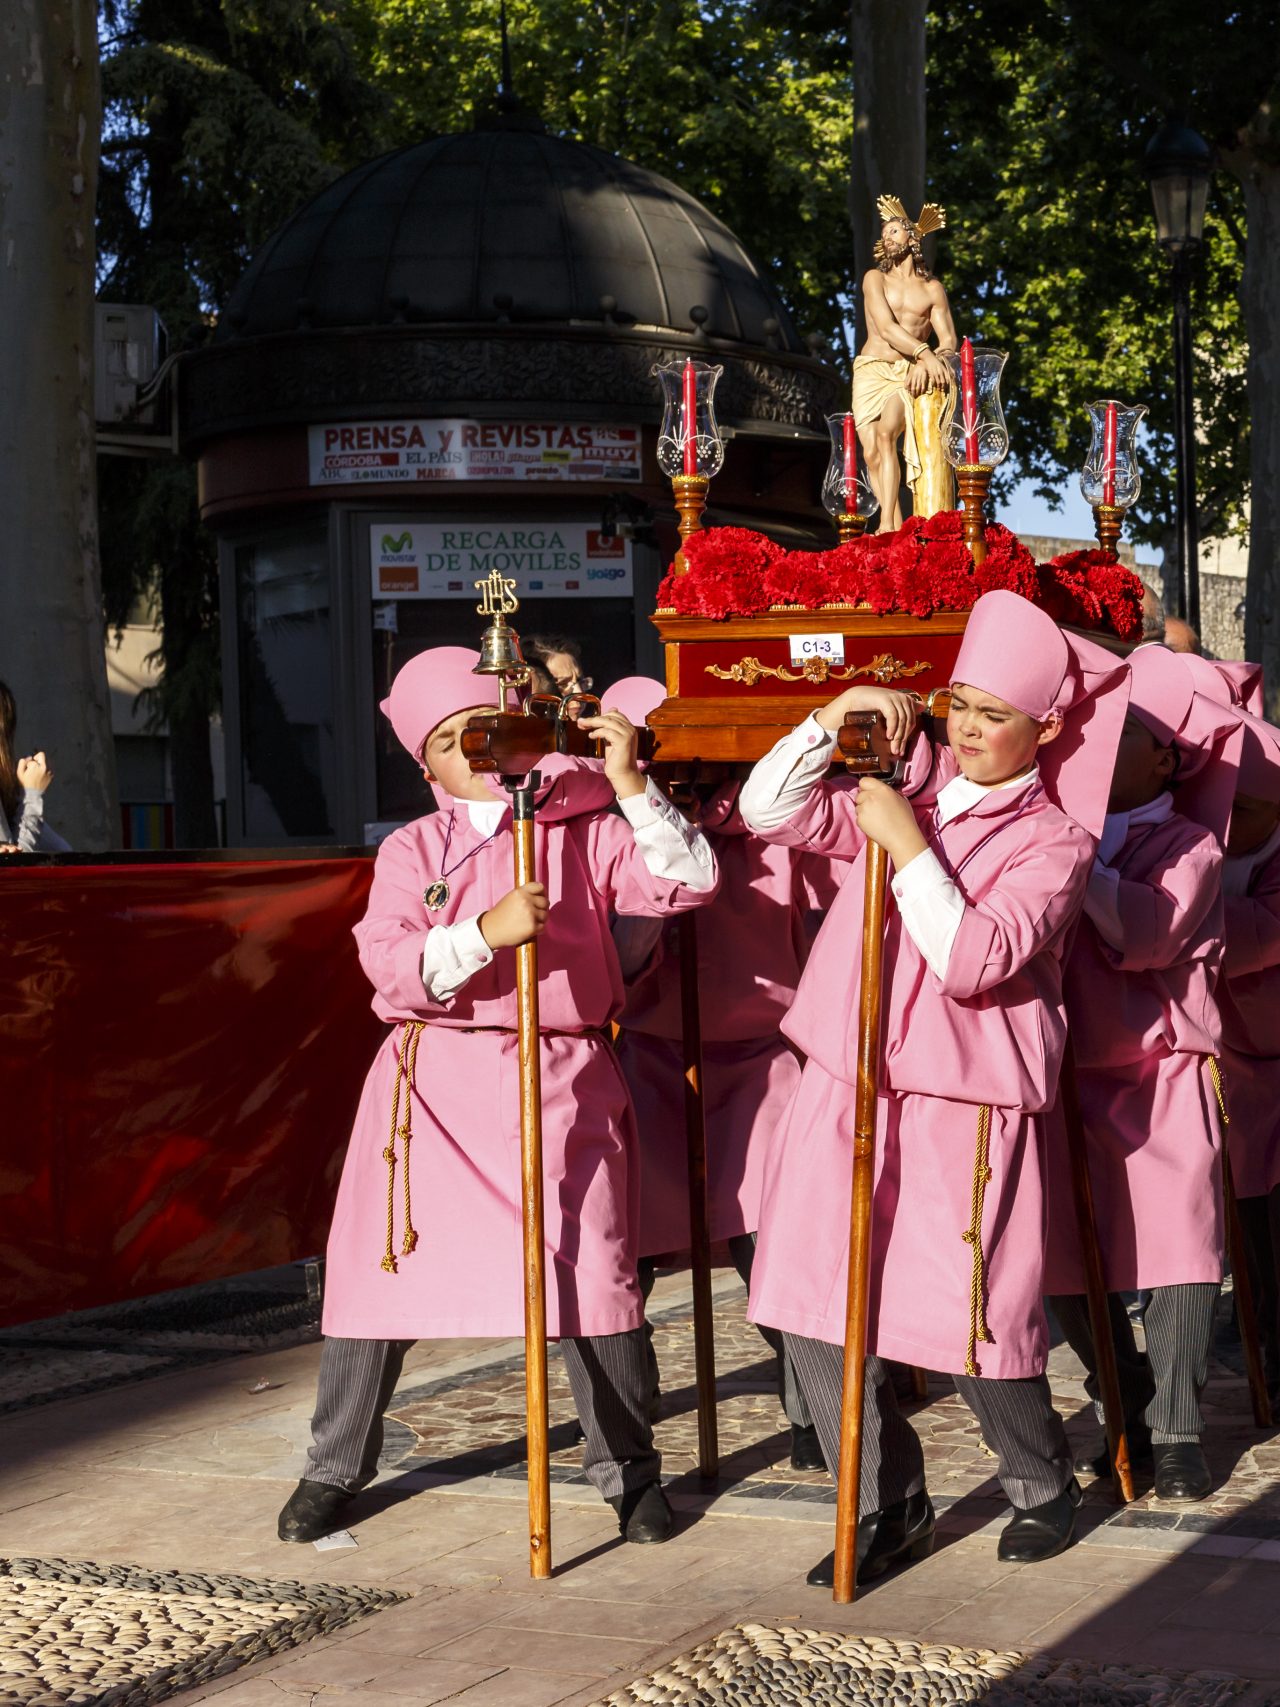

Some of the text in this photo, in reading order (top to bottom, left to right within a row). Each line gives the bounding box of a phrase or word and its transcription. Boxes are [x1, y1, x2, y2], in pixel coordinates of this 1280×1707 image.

[325, 424, 593, 453] PRENSA y REVISTAS
[406, 452, 426, 464] EL
[585, 447, 633, 459] muy
[319, 468, 345, 479] ABC
[370, 469, 409, 479] MUNDO
[416, 468, 456, 479] MARCA
[441, 530, 565, 550] RECARGA
[381, 554, 416, 562] movistar
[426, 552, 581, 571] DE MOVILES
[587, 568, 625, 580] yoigo
[381, 581, 416, 591] orange
[803, 641, 831, 653] C1-3
